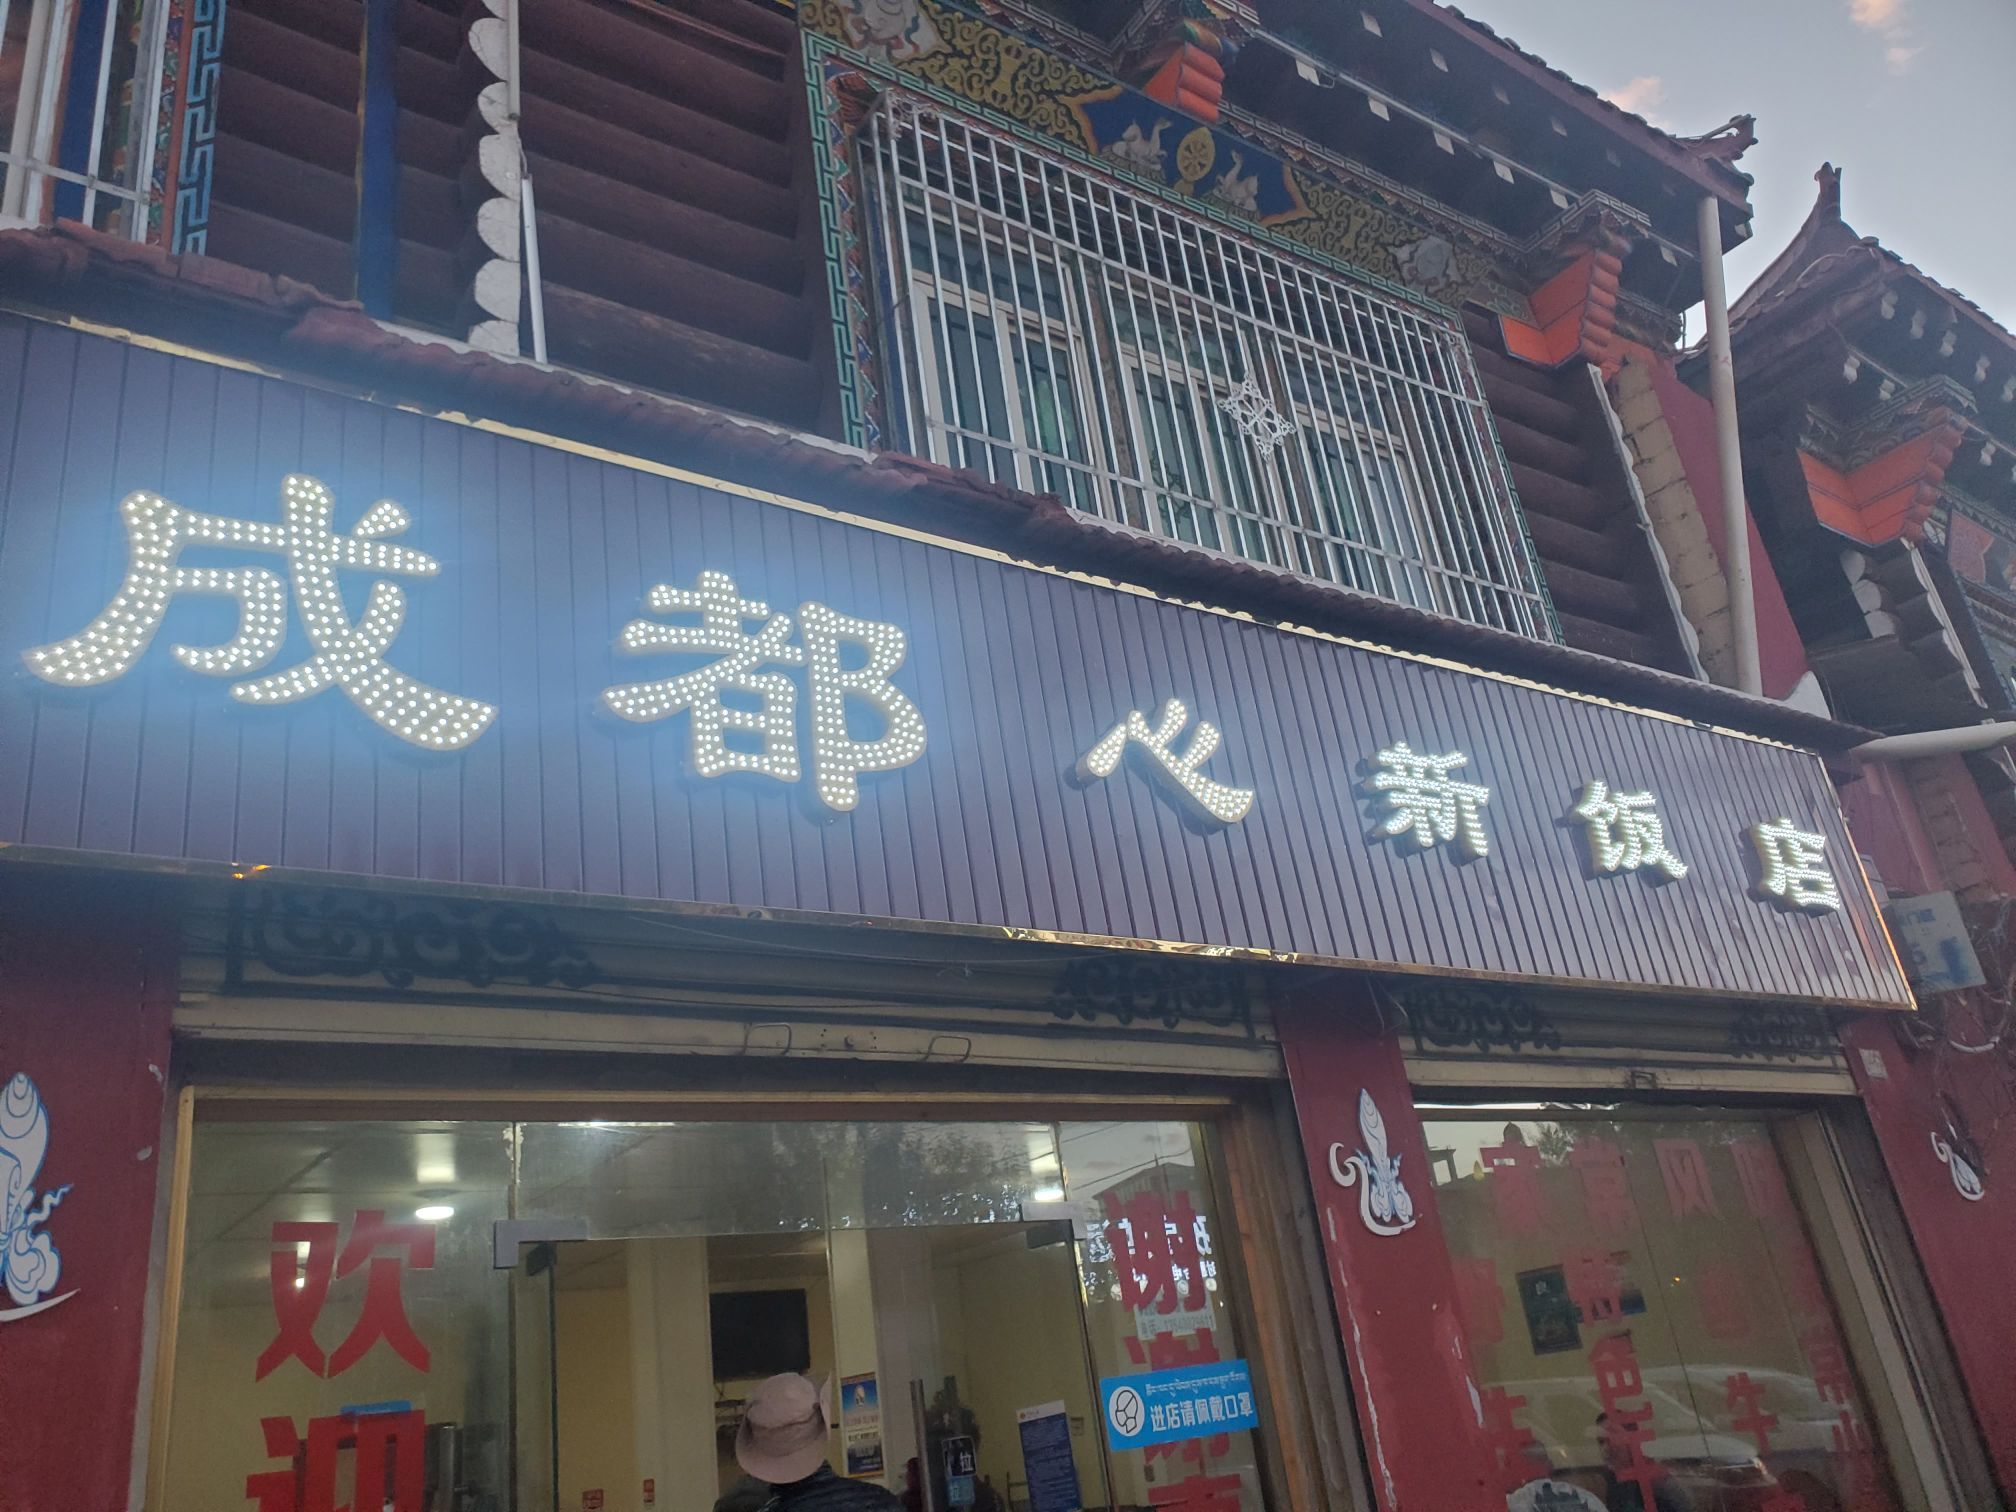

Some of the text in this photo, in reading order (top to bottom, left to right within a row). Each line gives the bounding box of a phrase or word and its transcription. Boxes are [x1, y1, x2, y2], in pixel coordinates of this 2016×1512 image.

[246, 1209, 435, 1512] 欢迎
[1149, 1390, 1254, 1433] 进店请佩戴口罩
